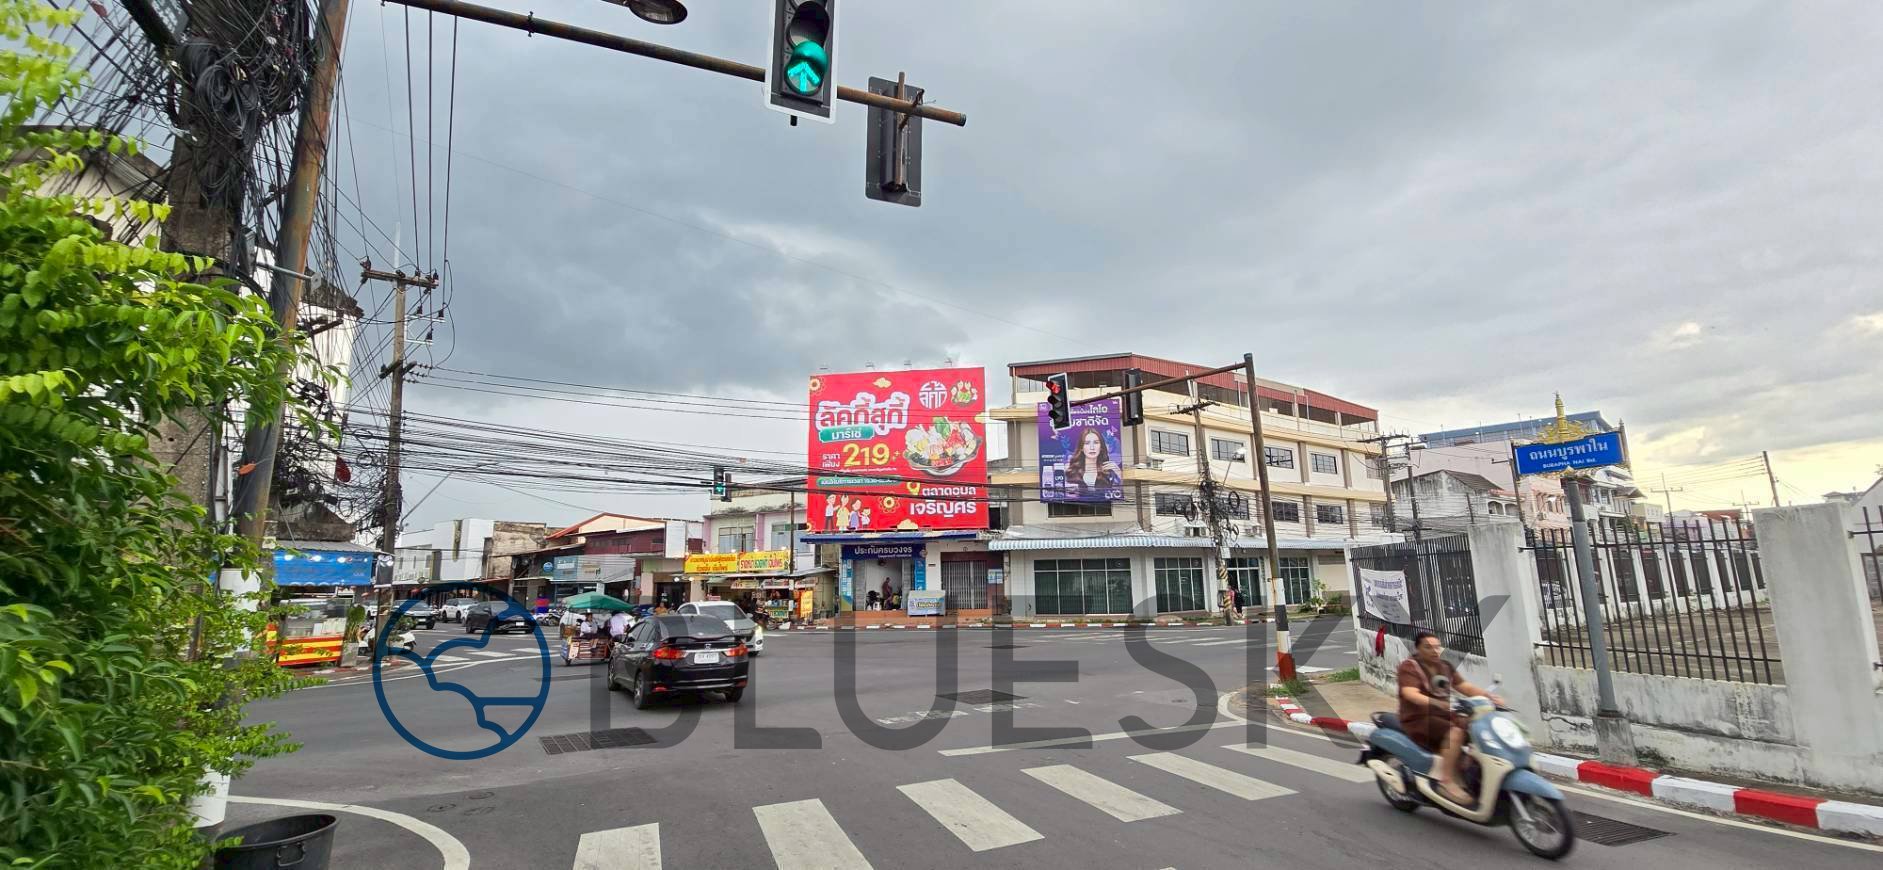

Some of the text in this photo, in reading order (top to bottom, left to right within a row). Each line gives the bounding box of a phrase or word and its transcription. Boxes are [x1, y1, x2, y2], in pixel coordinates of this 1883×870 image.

[842, 443, 890, 467] 219
[1529, 438, 1609, 460] ถนนบูรพาใน
[854, 545, 913, 555] ประกันครบวงจร
